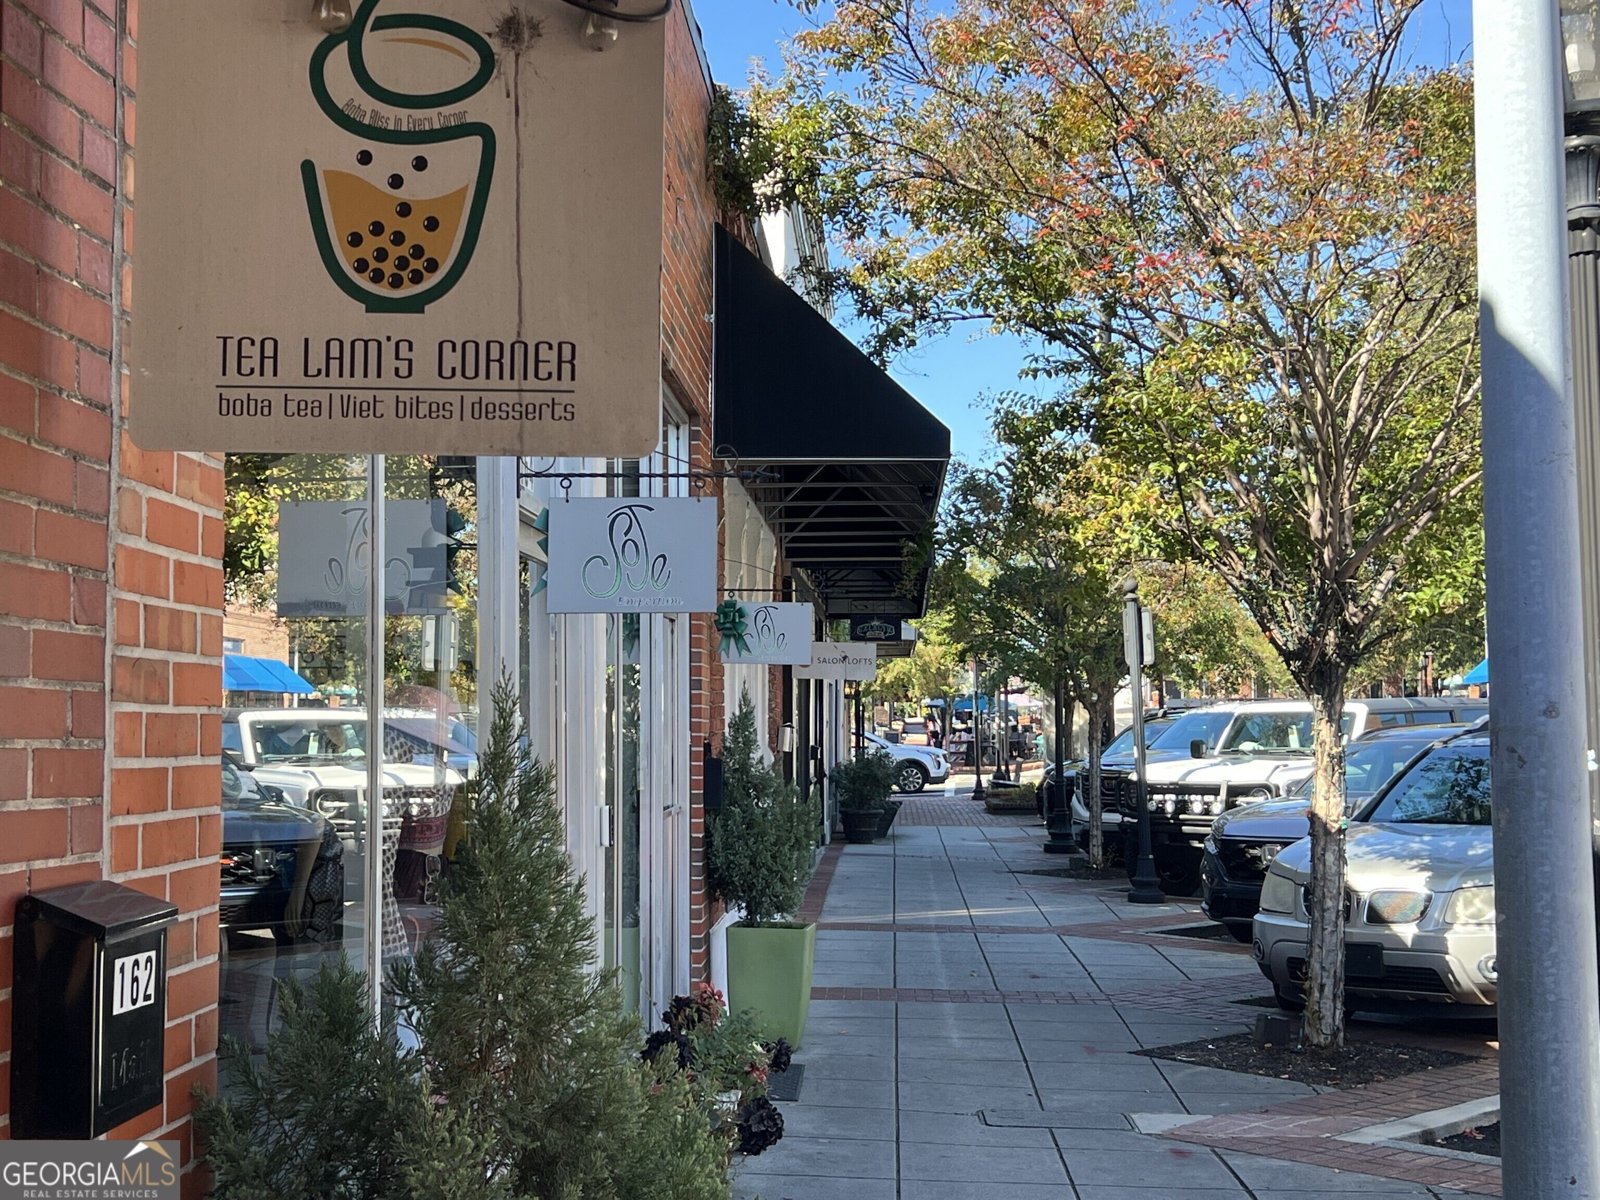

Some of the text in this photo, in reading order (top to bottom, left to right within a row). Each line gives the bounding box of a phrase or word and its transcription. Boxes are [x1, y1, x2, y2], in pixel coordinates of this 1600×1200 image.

[342, 98, 367, 123] Boba
[369, 109, 390, 130] Bliss
[407, 114, 435, 132] Every
[437, 110, 468, 128] Corner
[216, 335, 576, 382] TEA LAM'S CORNER
[218, 392, 272, 417] boba
[816, 656, 873, 666] SALON LOFTS
[119, 955, 153, 1009] 162
